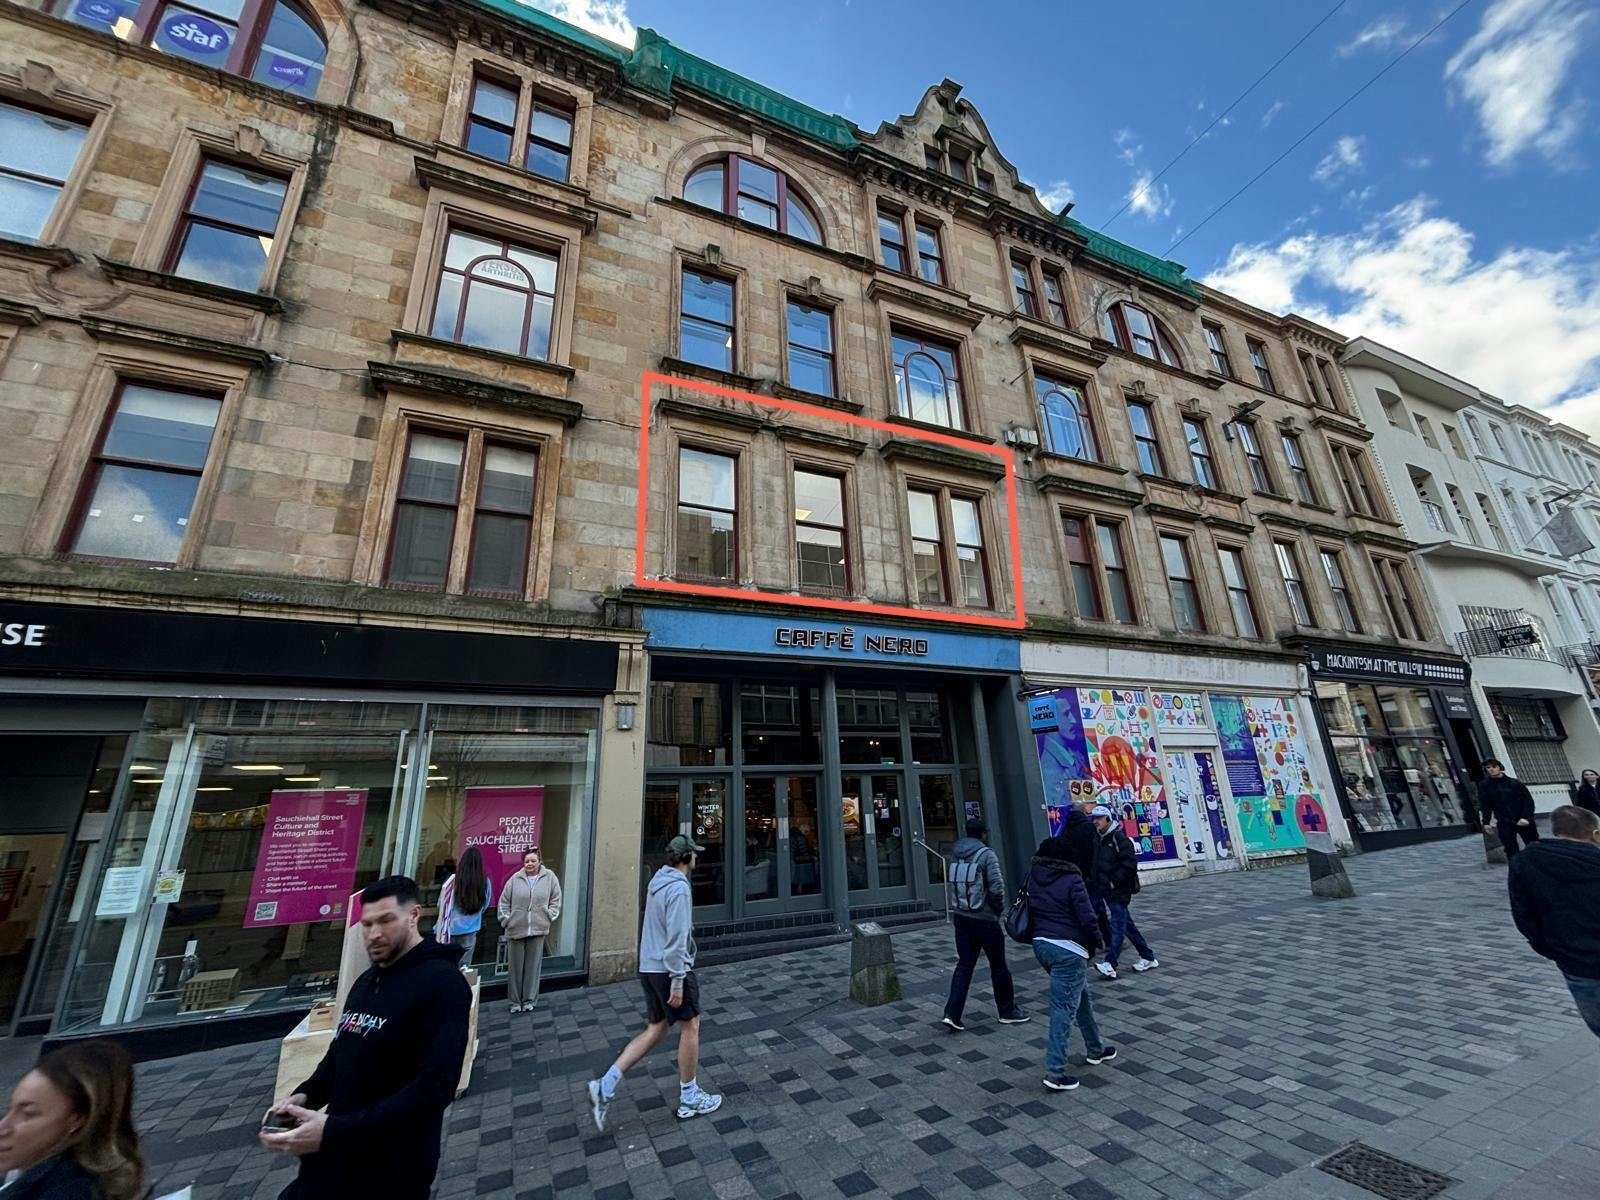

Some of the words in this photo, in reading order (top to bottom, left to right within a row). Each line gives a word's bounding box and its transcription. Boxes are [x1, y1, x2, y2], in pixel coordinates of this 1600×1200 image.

[170, 23, 222, 48] staf
[0, 623, 46, 646] SE
[775, 626, 855, 650] CAFFÈ
[865, 633, 930, 656] NERO
[1326, 653, 1372, 671] MACKINTOSH
[1373, 660, 1382, 672] AT
[1382, 660, 1397, 673] THE
[1397, 662, 1423, 675] WILLOW
[1032, 712, 1054, 721] NERO
[275, 815, 320, 823] Sauchiehall
[499, 816, 535, 826] PEOPLE
[506, 825, 534, 834] MAKE
[466, 834, 534, 846] SAUCHIEHALL
[497, 843, 533, 854] STREET
